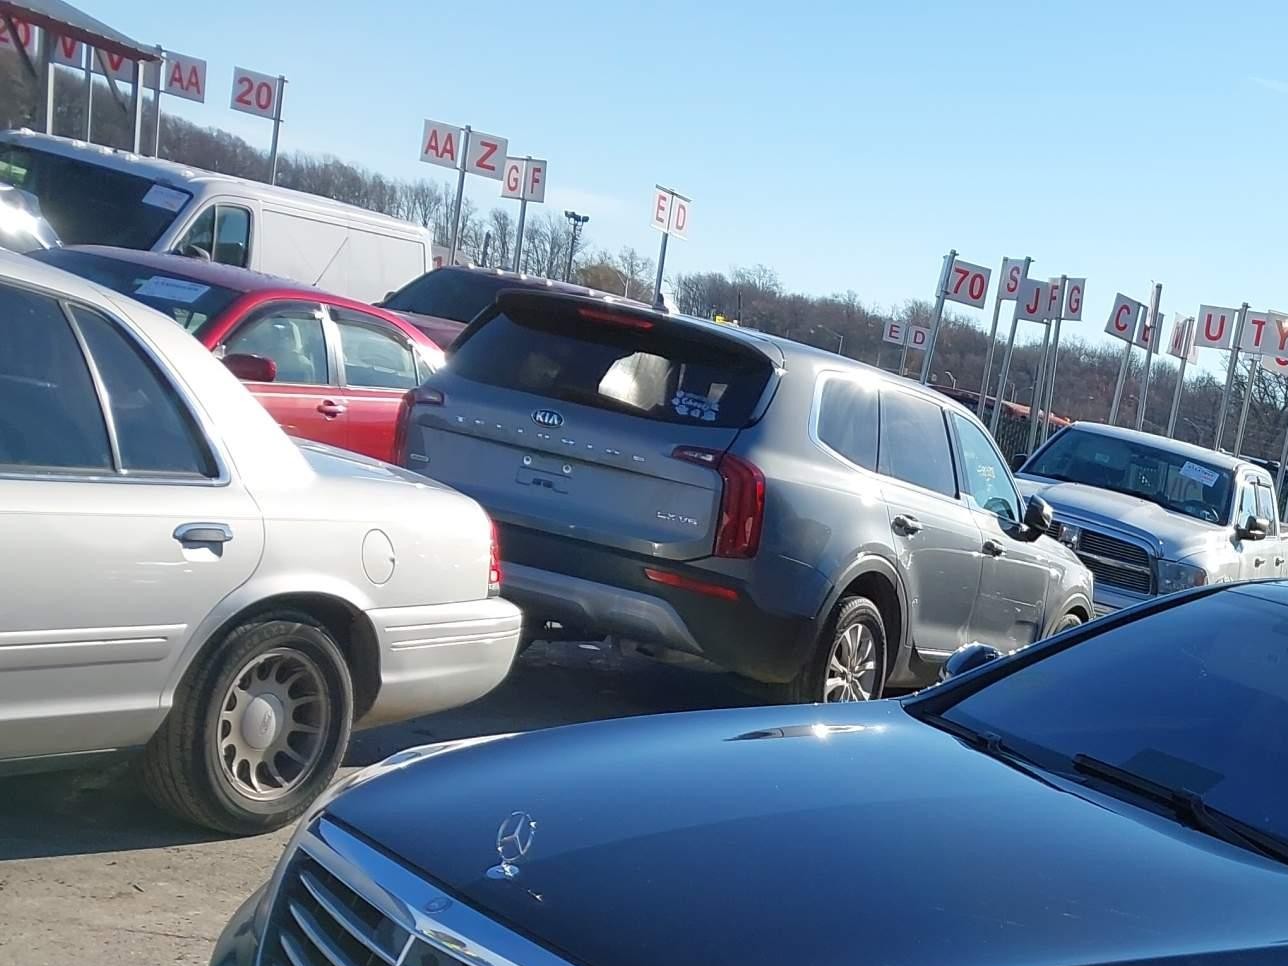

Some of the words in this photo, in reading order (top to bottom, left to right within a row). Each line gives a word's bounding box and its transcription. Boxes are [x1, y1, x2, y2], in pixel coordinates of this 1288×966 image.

[168, 60, 201, 95] AA
[235, 76, 273, 110] 20
[424, 129, 455, 161] AA
[475, 140, 498, 171] Z
[507, 164, 520, 192] G
[530, 167, 542, 194] F
[655, 194, 667, 223] E
[675, 203, 687, 231] D
[952, 266, 985, 300] 70
[1007, 266, 1020, 293] S
[1025, 287, 1041, 314] J
[1048, 284, 1058, 312] F
[1069, 285, 1081, 313] G
[889, 324, 901, 339] E
[1115, 304, 1131, 331] C
[1205, 313, 1226, 341] U
[913, 330, 926, 345] D
[1251, 319, 1266, 347] T
[535, 411, 558, 425] KIA
